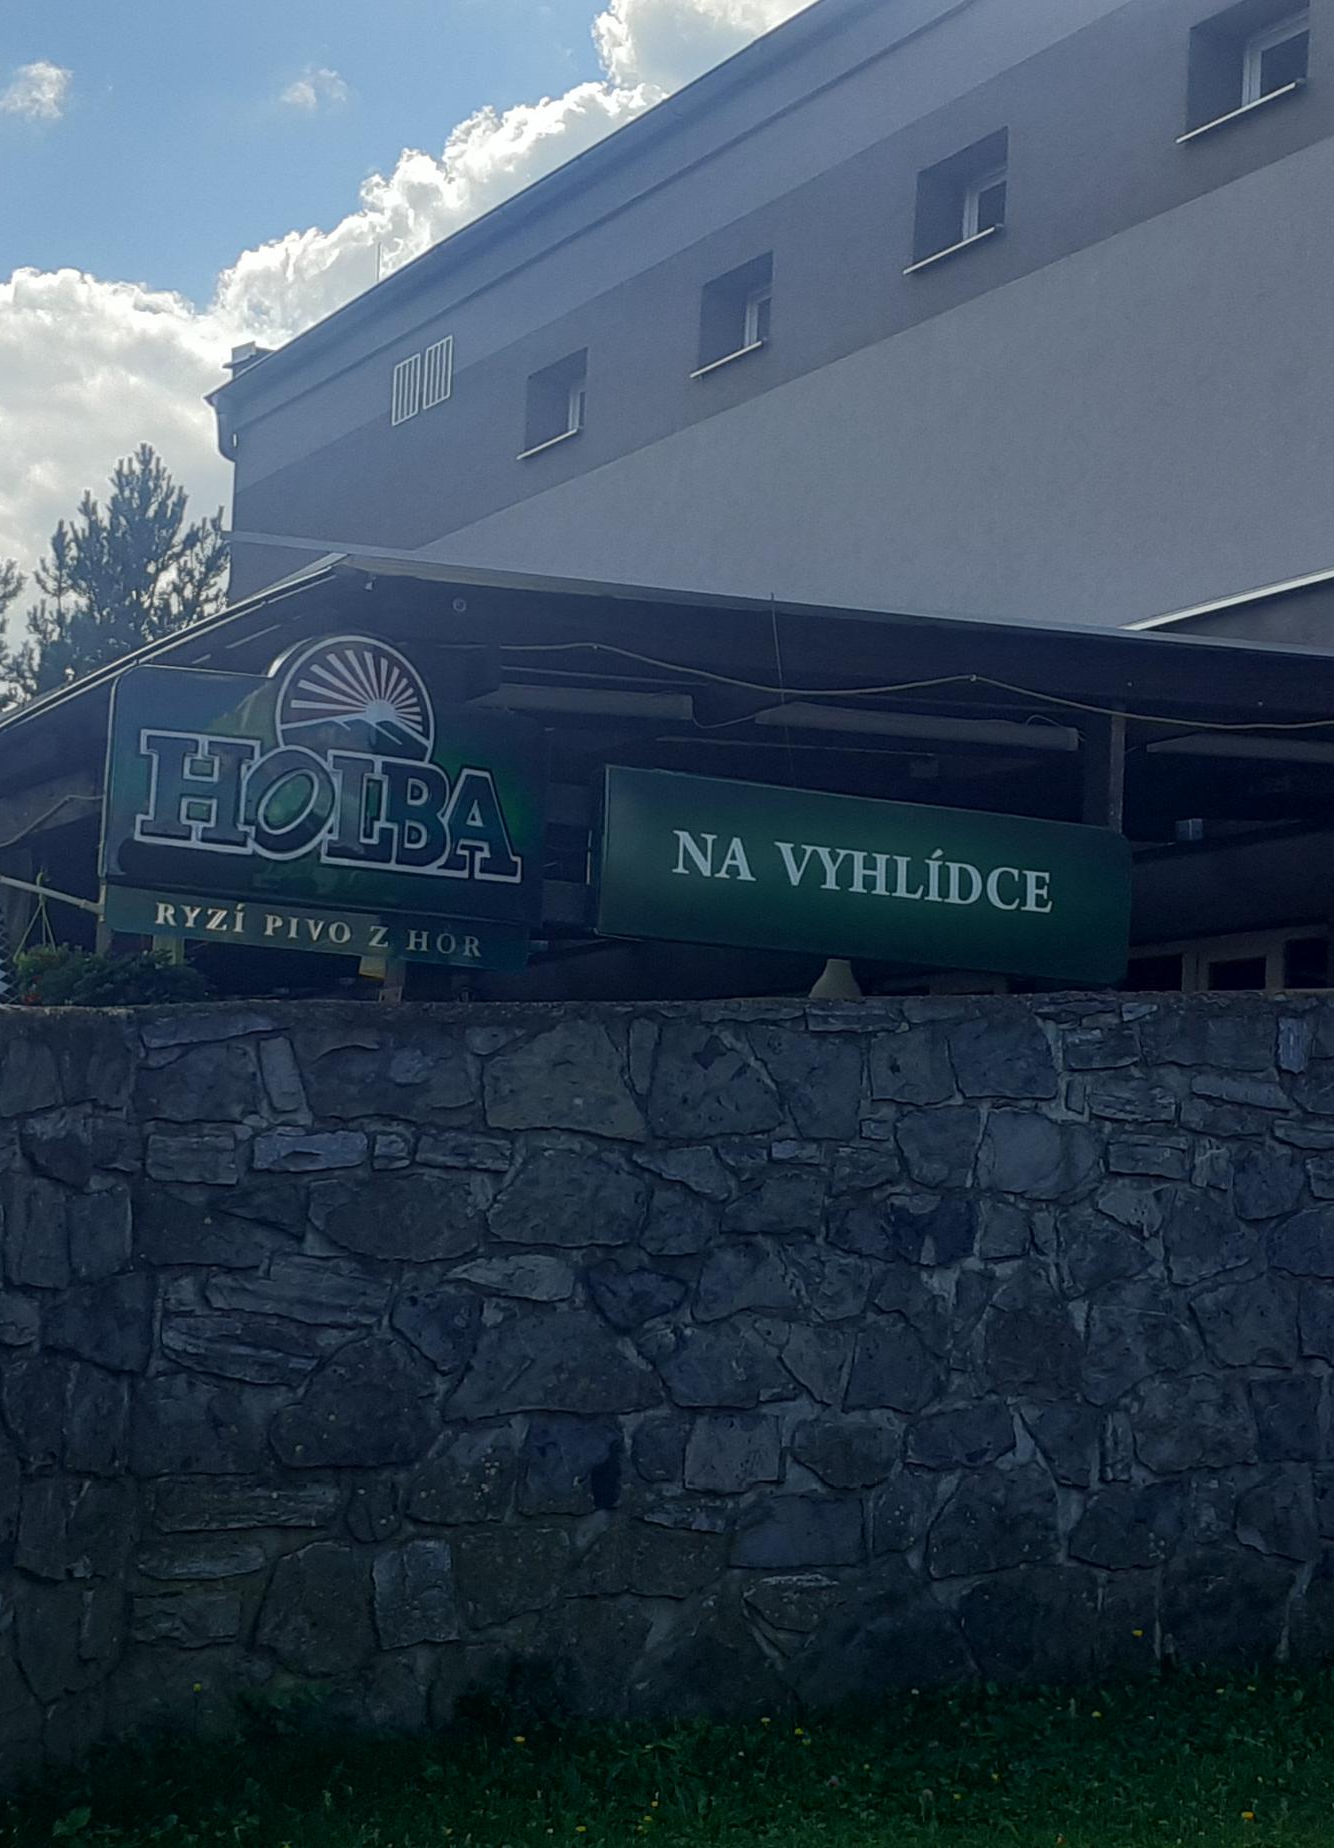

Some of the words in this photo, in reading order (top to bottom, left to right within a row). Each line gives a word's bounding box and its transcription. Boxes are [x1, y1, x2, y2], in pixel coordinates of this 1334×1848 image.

[133, 728, 523, 884] HOLBA
[671, 829, 757, 882] NA
[774, 840, 1054, 914] VYHLÍDCE
[154, 901, 247, 934] RYZÍ
[264, 914, 352, 944] PIVO
[369, 925, 389, 948] Z
[407, 930, 482, 957] HOR
